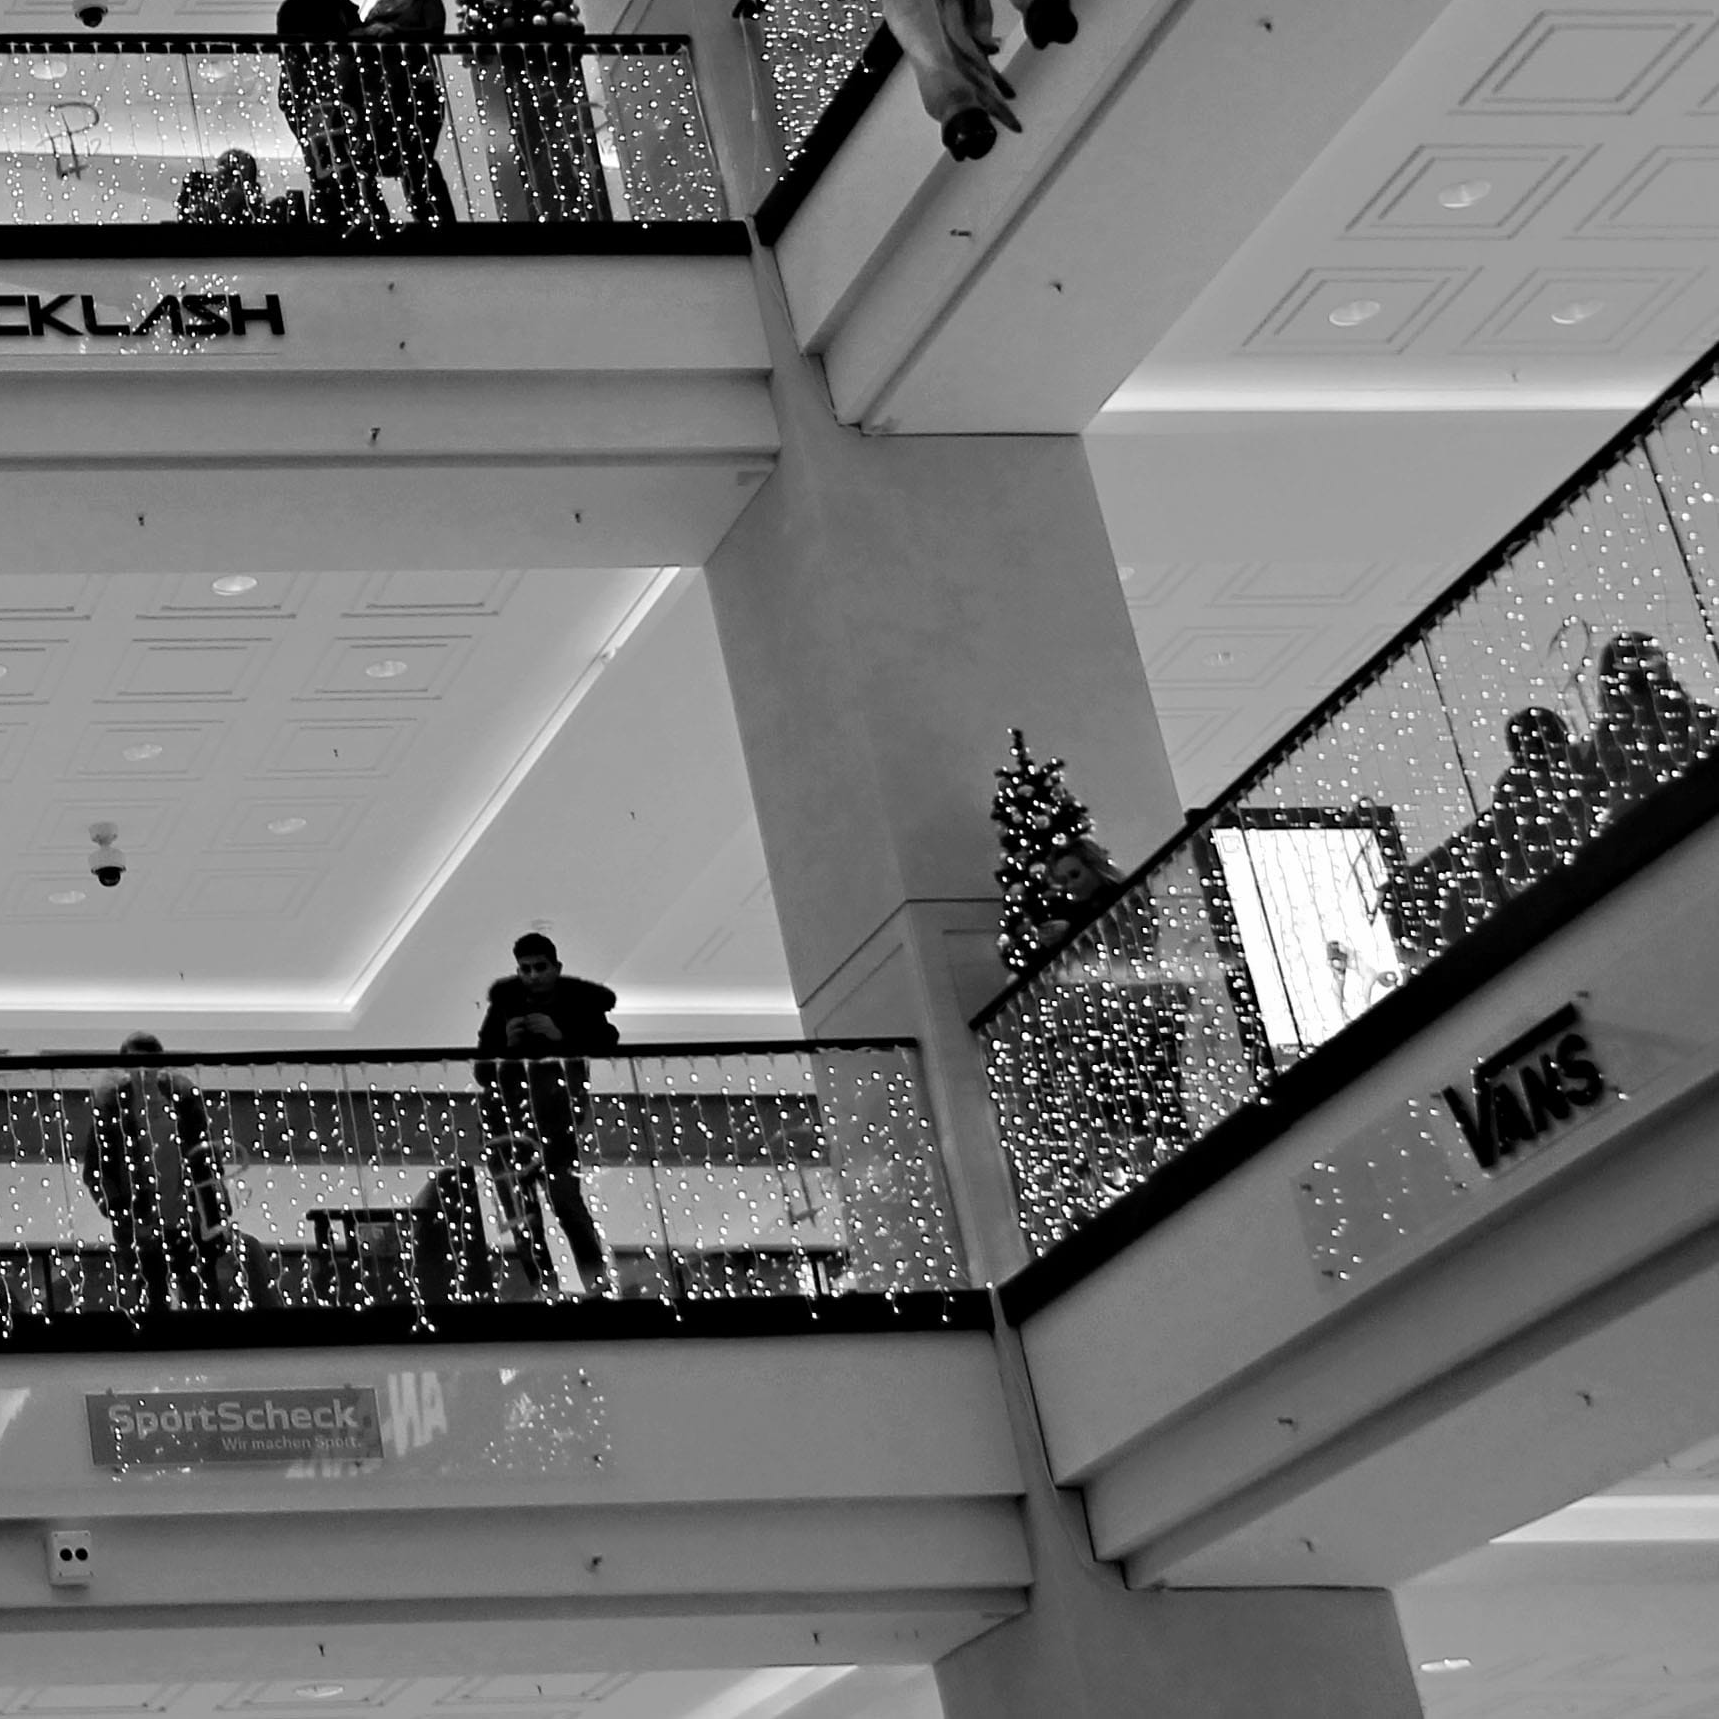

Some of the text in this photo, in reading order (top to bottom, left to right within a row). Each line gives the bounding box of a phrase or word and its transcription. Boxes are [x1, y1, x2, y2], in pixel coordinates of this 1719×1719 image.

[1442, 1001, 1605, 1169] VANS
[108, 1398, 359, 1441] SportScheck
[220, 1436, 247, 1453] Wir
[251, 1433, 311, 1451] machen
